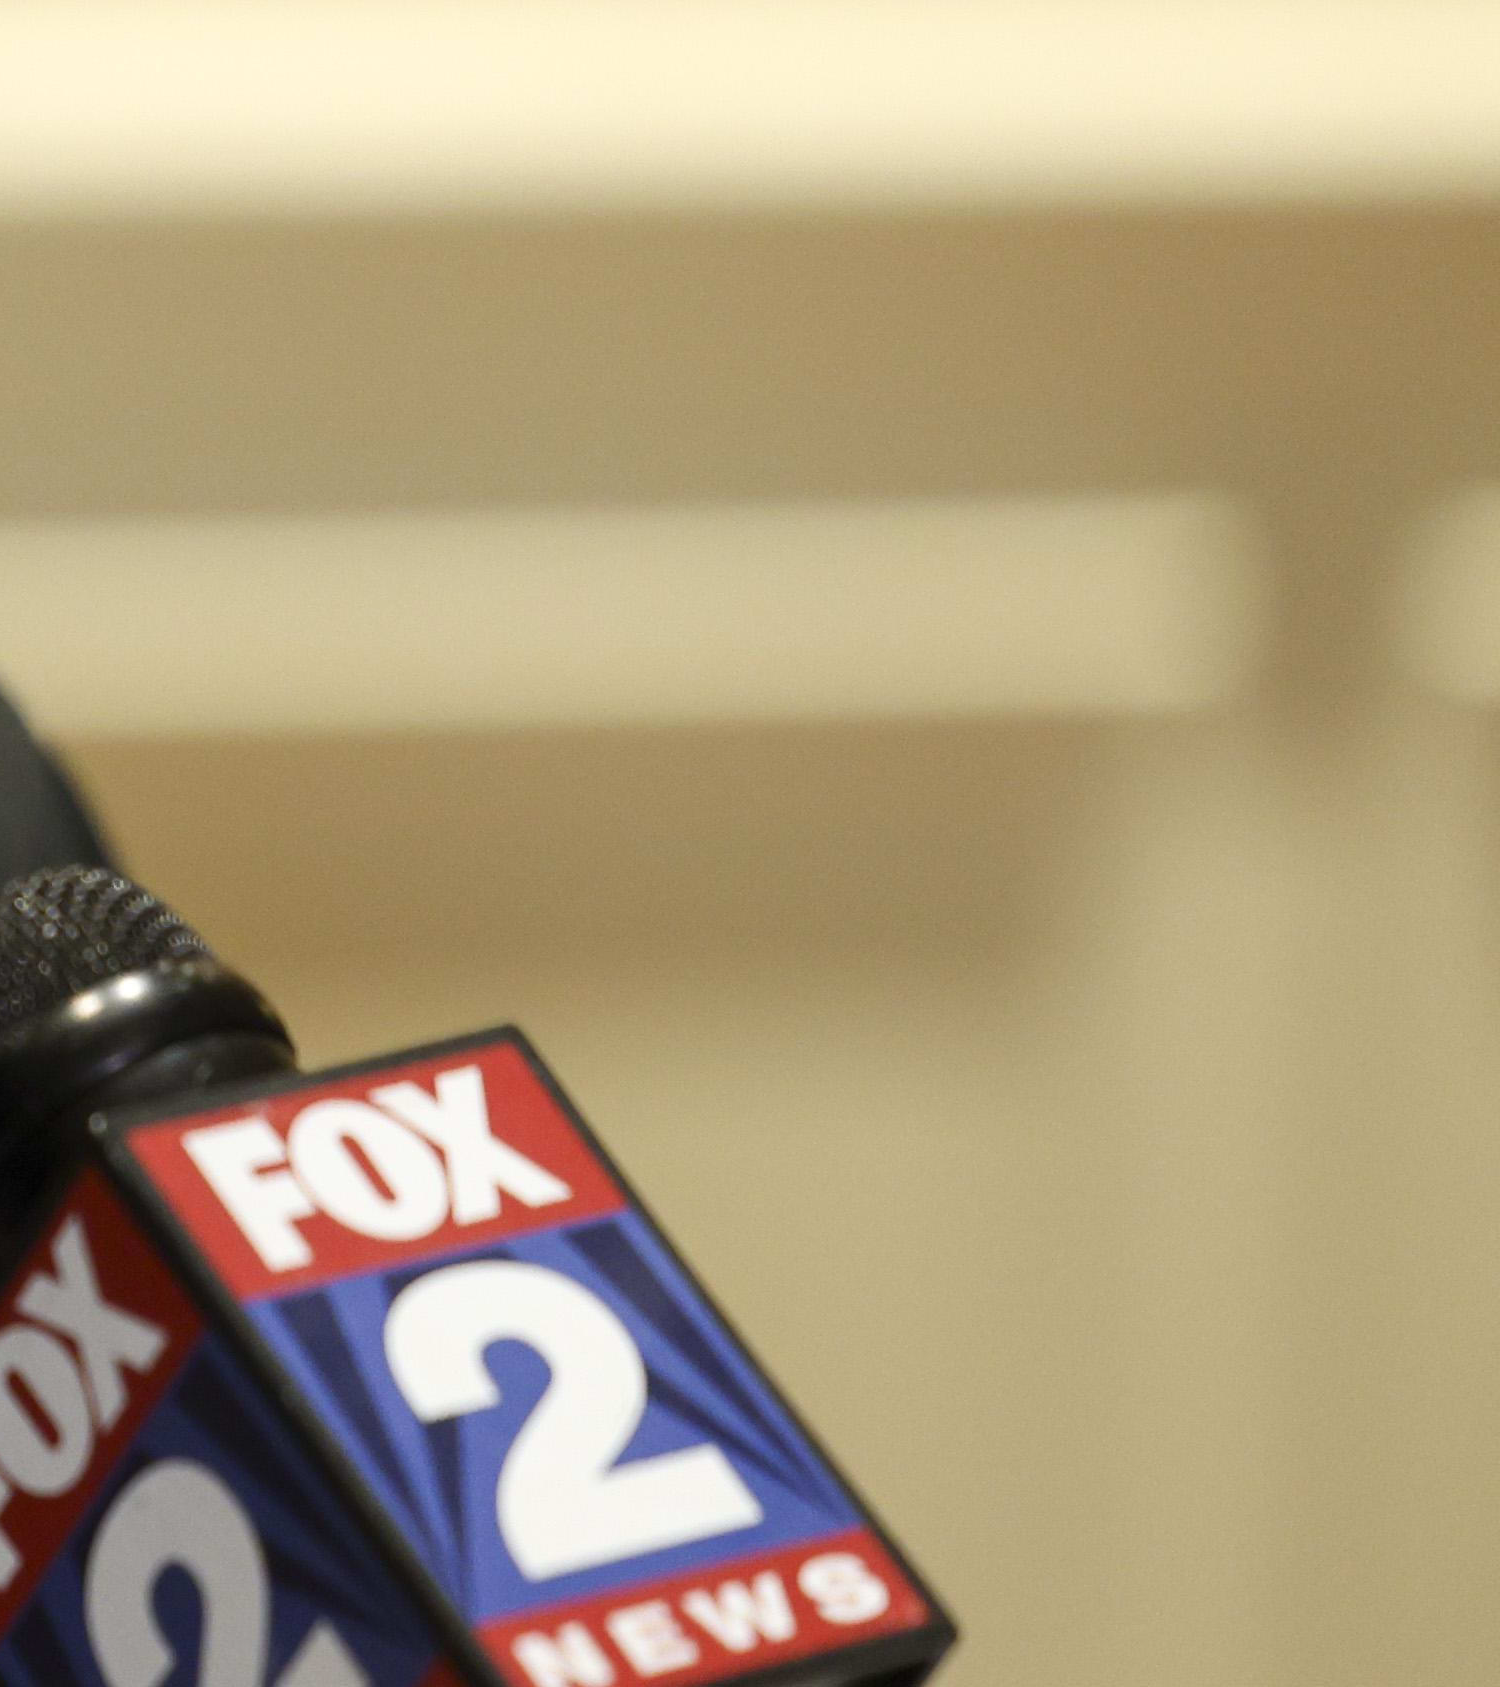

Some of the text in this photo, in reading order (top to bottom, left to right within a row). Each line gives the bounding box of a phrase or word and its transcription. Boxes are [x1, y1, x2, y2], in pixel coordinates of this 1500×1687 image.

[182, 1064, 572, 1273] FOX
[382, 1257, 764, 1583] 2
[83, 1456, 373, 1687] 2
[510, 1551, 891, 1687] NEWS
